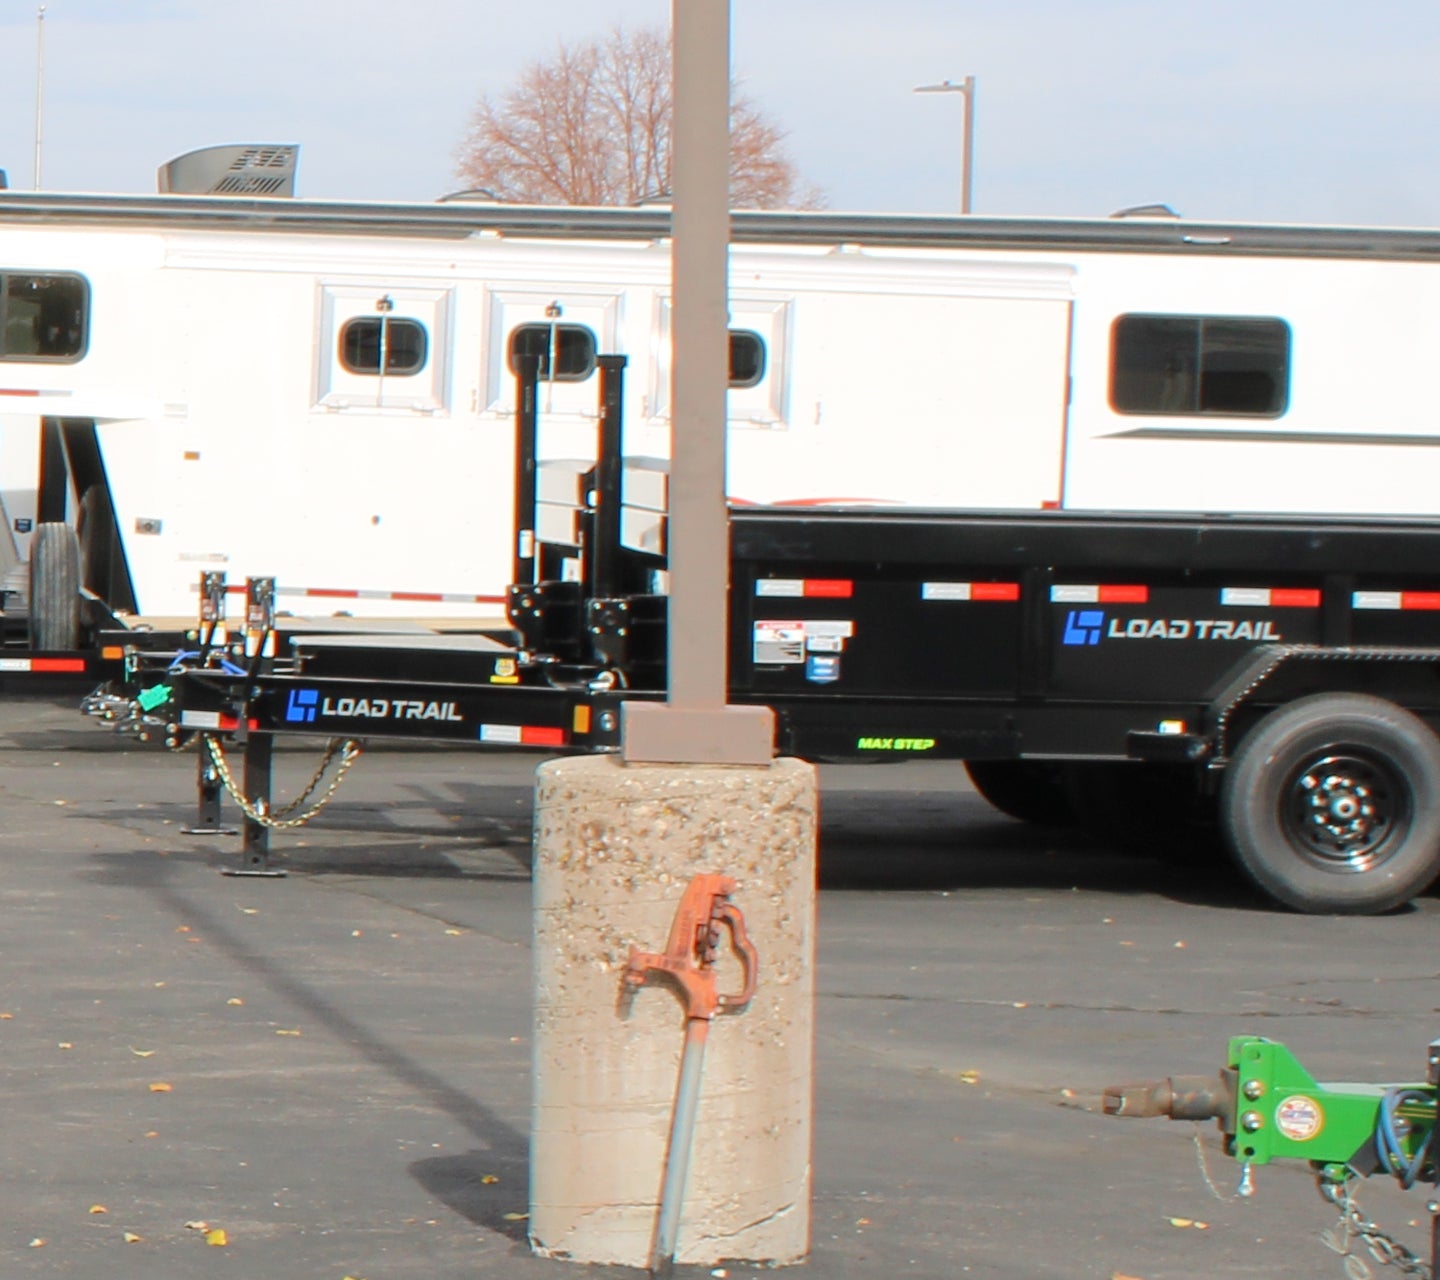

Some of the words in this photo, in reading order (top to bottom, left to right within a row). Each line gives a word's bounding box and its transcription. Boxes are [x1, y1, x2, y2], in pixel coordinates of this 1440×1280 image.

[1107, 618, 1191, 639] LOAD
[1194, 619, 1282, 641] TRAIL
[321, 697, 389, 718] LOAD
[391, 700, 464, 721] TRAIL
[858, 738, 893, 750] MAX
[893, 738, 936, 750] STEP
